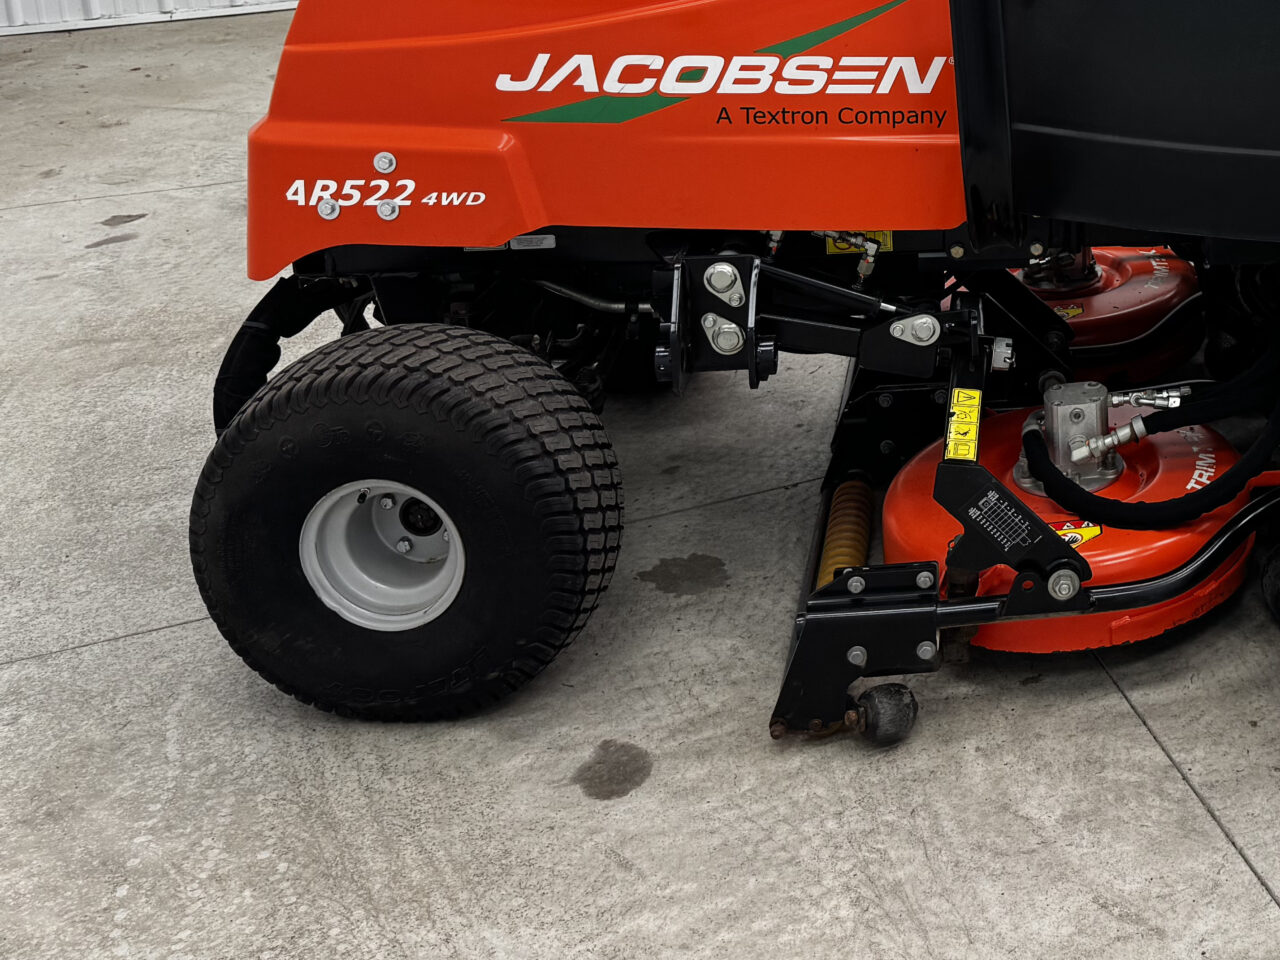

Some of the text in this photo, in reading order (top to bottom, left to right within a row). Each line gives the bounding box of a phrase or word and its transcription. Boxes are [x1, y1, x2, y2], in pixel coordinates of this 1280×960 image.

[495, 53, 947, 95] JACOBSEN
[716, 107, 947, 128] A Textron Company
[285, 179, 486, 206] AR522 4WD
